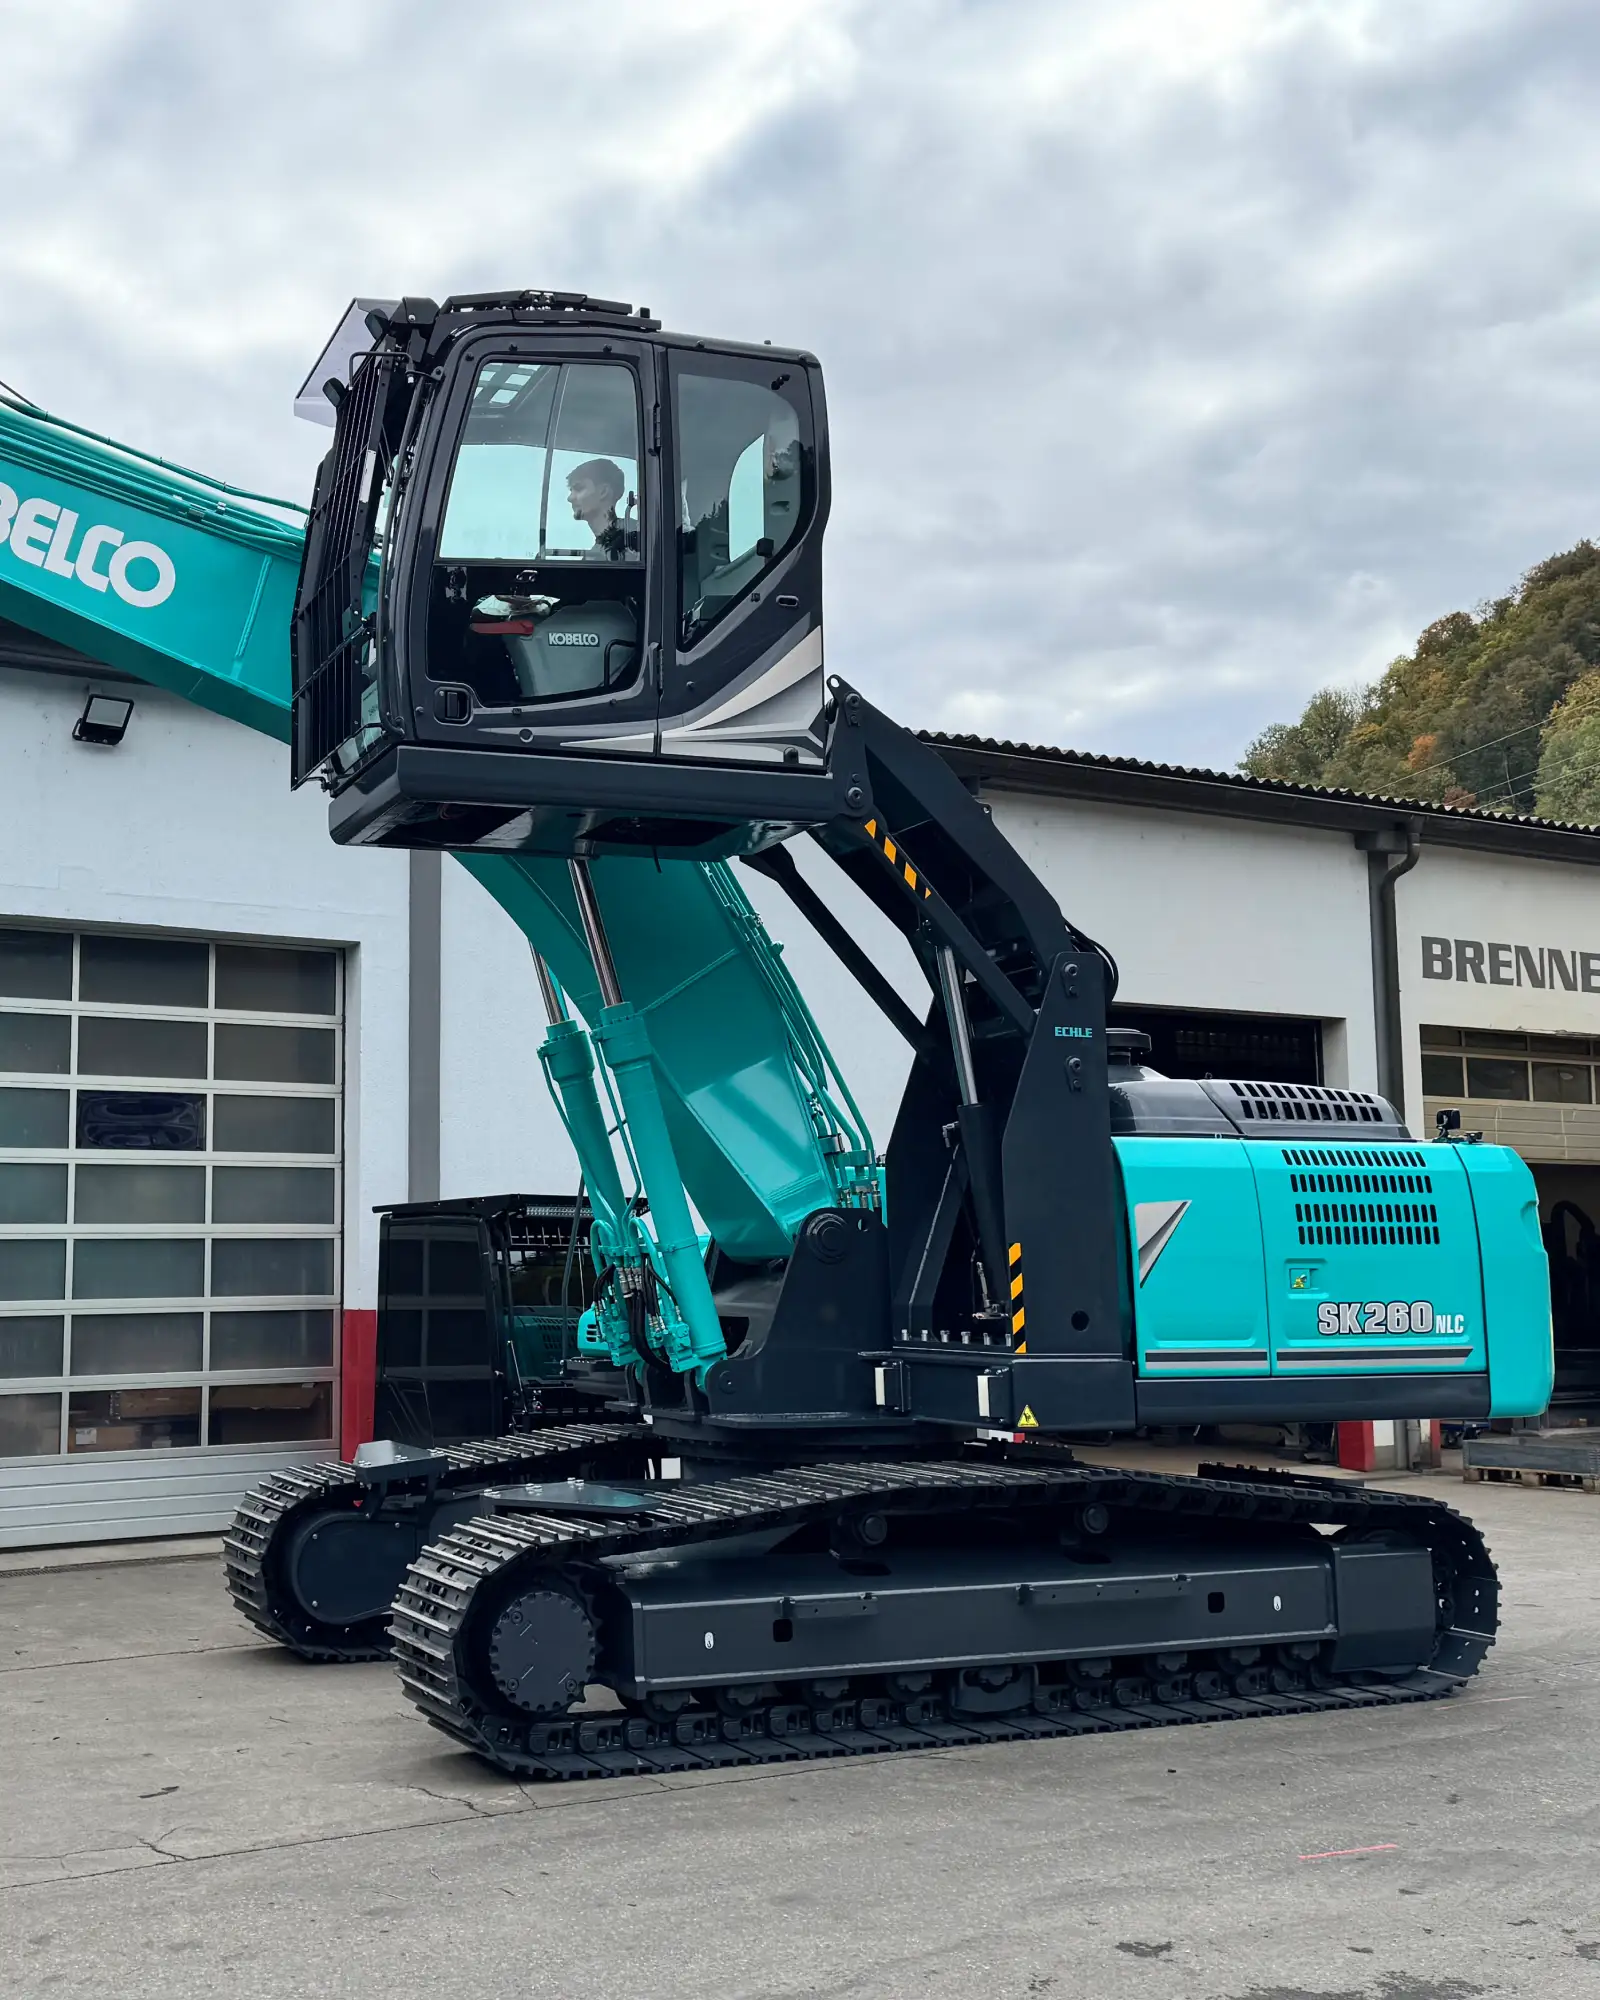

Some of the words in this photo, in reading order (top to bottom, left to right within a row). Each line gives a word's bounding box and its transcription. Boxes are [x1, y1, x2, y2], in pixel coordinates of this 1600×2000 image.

[548, 632, 599, 645] KOBELCO
[1055, 1026, 1093, 1037] ECHLE
[1317, 1301, 1434, 1335] SK260
[1435, 1314, 1465, 1334] NLC
